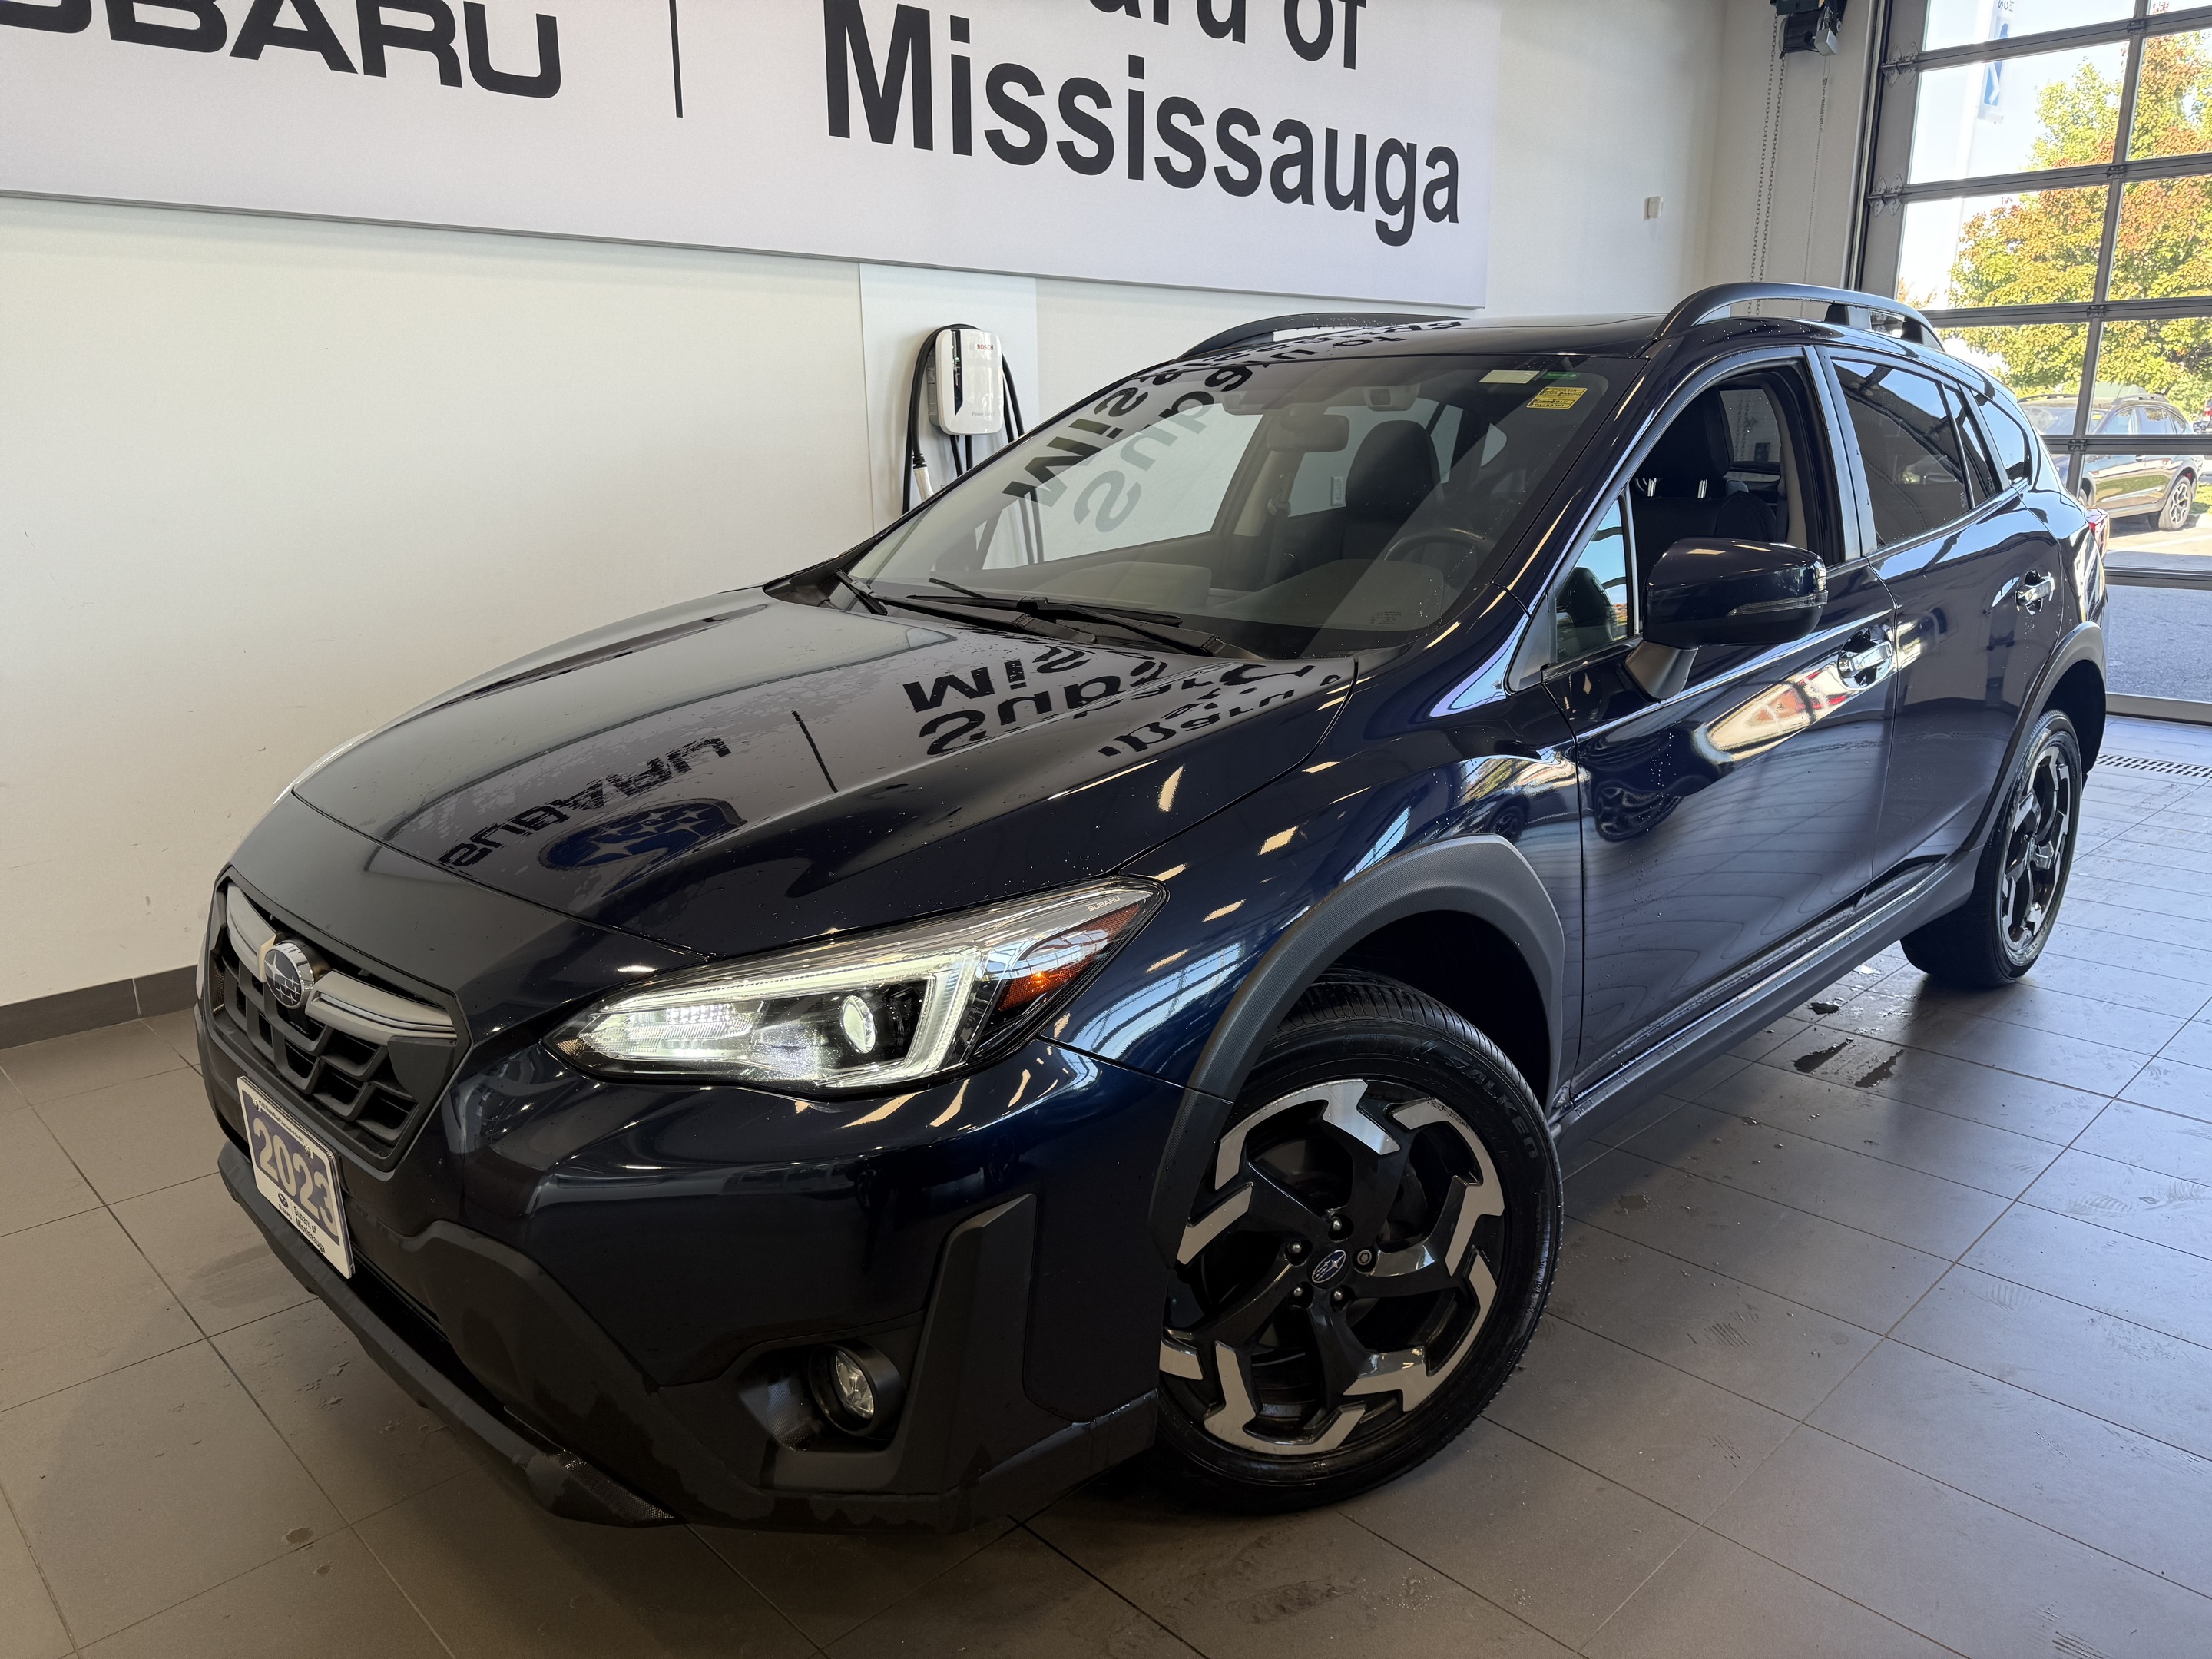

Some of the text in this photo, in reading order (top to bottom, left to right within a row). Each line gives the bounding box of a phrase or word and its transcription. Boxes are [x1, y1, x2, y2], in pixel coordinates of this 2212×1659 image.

[824, 0, 1459, 246] Mississauga
[1088, 896, 1121, 912] SUBARU
[253, 1118, 339, 1236] 2023
